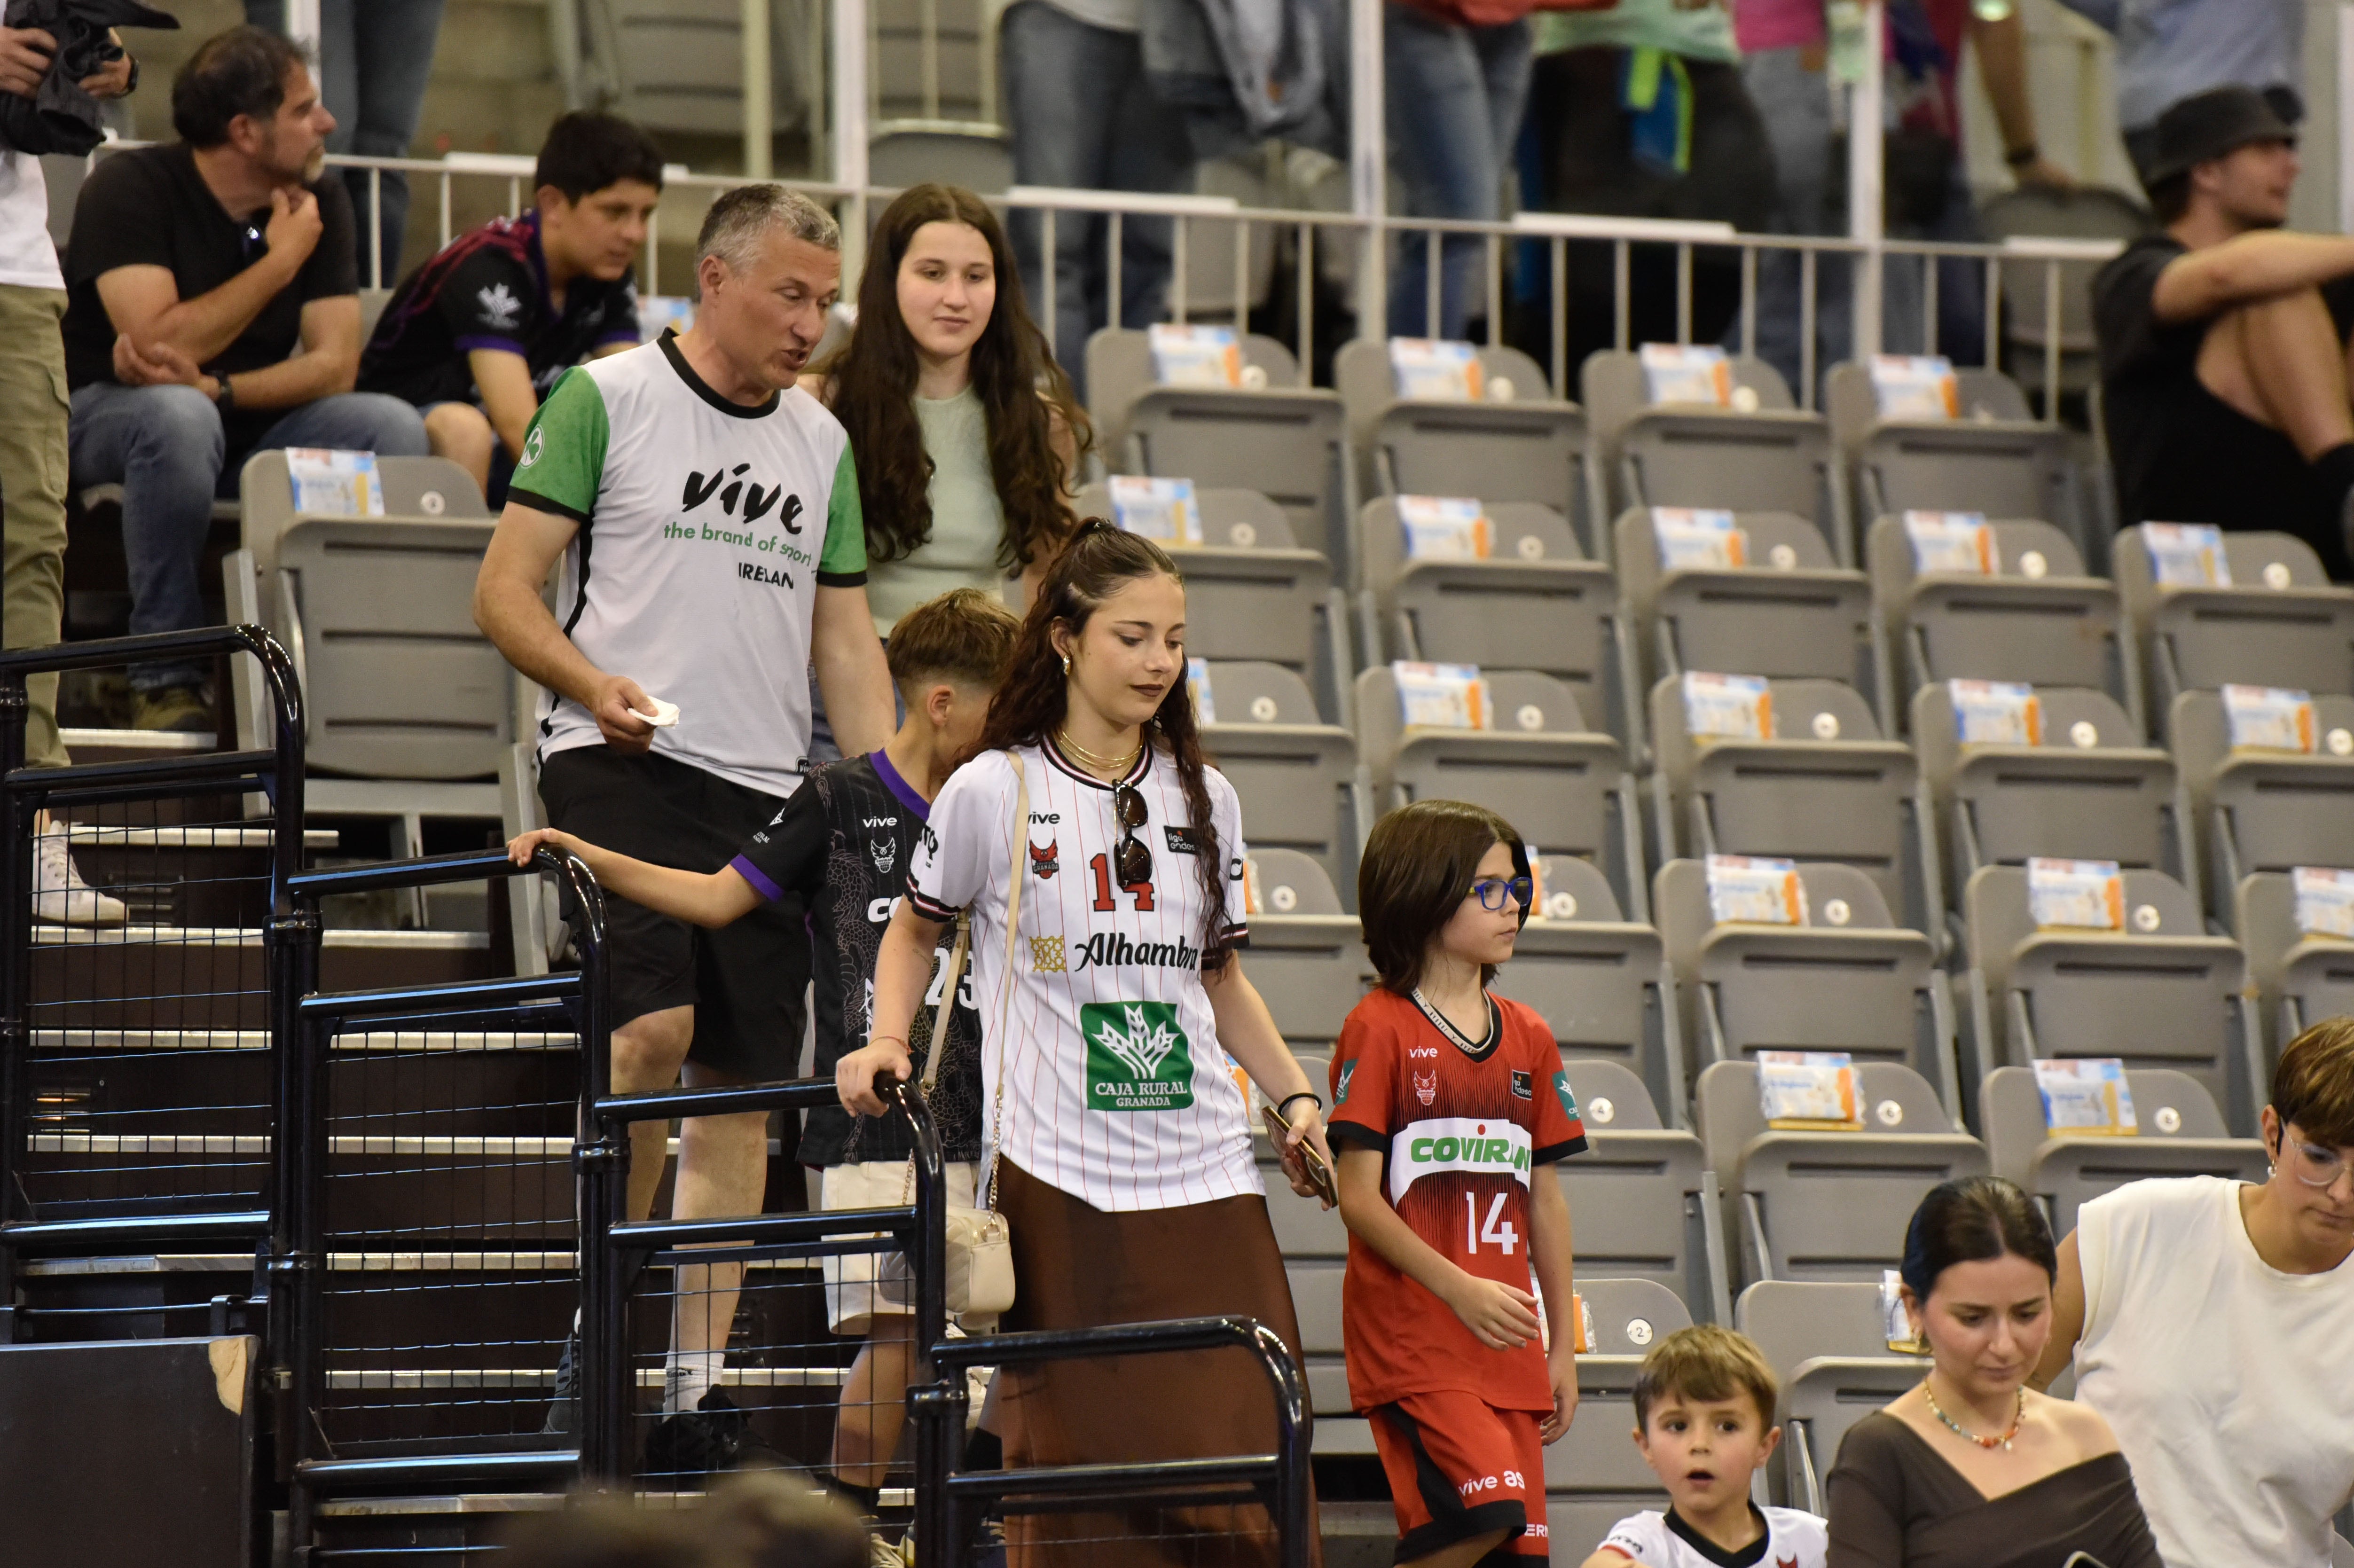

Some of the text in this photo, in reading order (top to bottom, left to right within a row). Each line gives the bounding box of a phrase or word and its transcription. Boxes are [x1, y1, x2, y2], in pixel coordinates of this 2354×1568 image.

[664, 521, 696, 539] the
[701, 522, 753, 547] brand
[758, 535, 778, 552] of
[738, 562, 794, 589] IRELAN
[863, 816, 897, 828] vive
[1170, 842, 1196, 851] endes
[1075, 932, 1199, 971] Alhambra
[1409, 1046, 1438, 1058] vive
[1095, 1082, 1188, 1096] CAJA RURAL
[1116, 1097, 1171, 1107] GRANADA
[1466, 1191, 1518, 1255] 14
[1636, 1327, 1644, 1338] 2
[1459, 1476, 1498, 1497] vive
